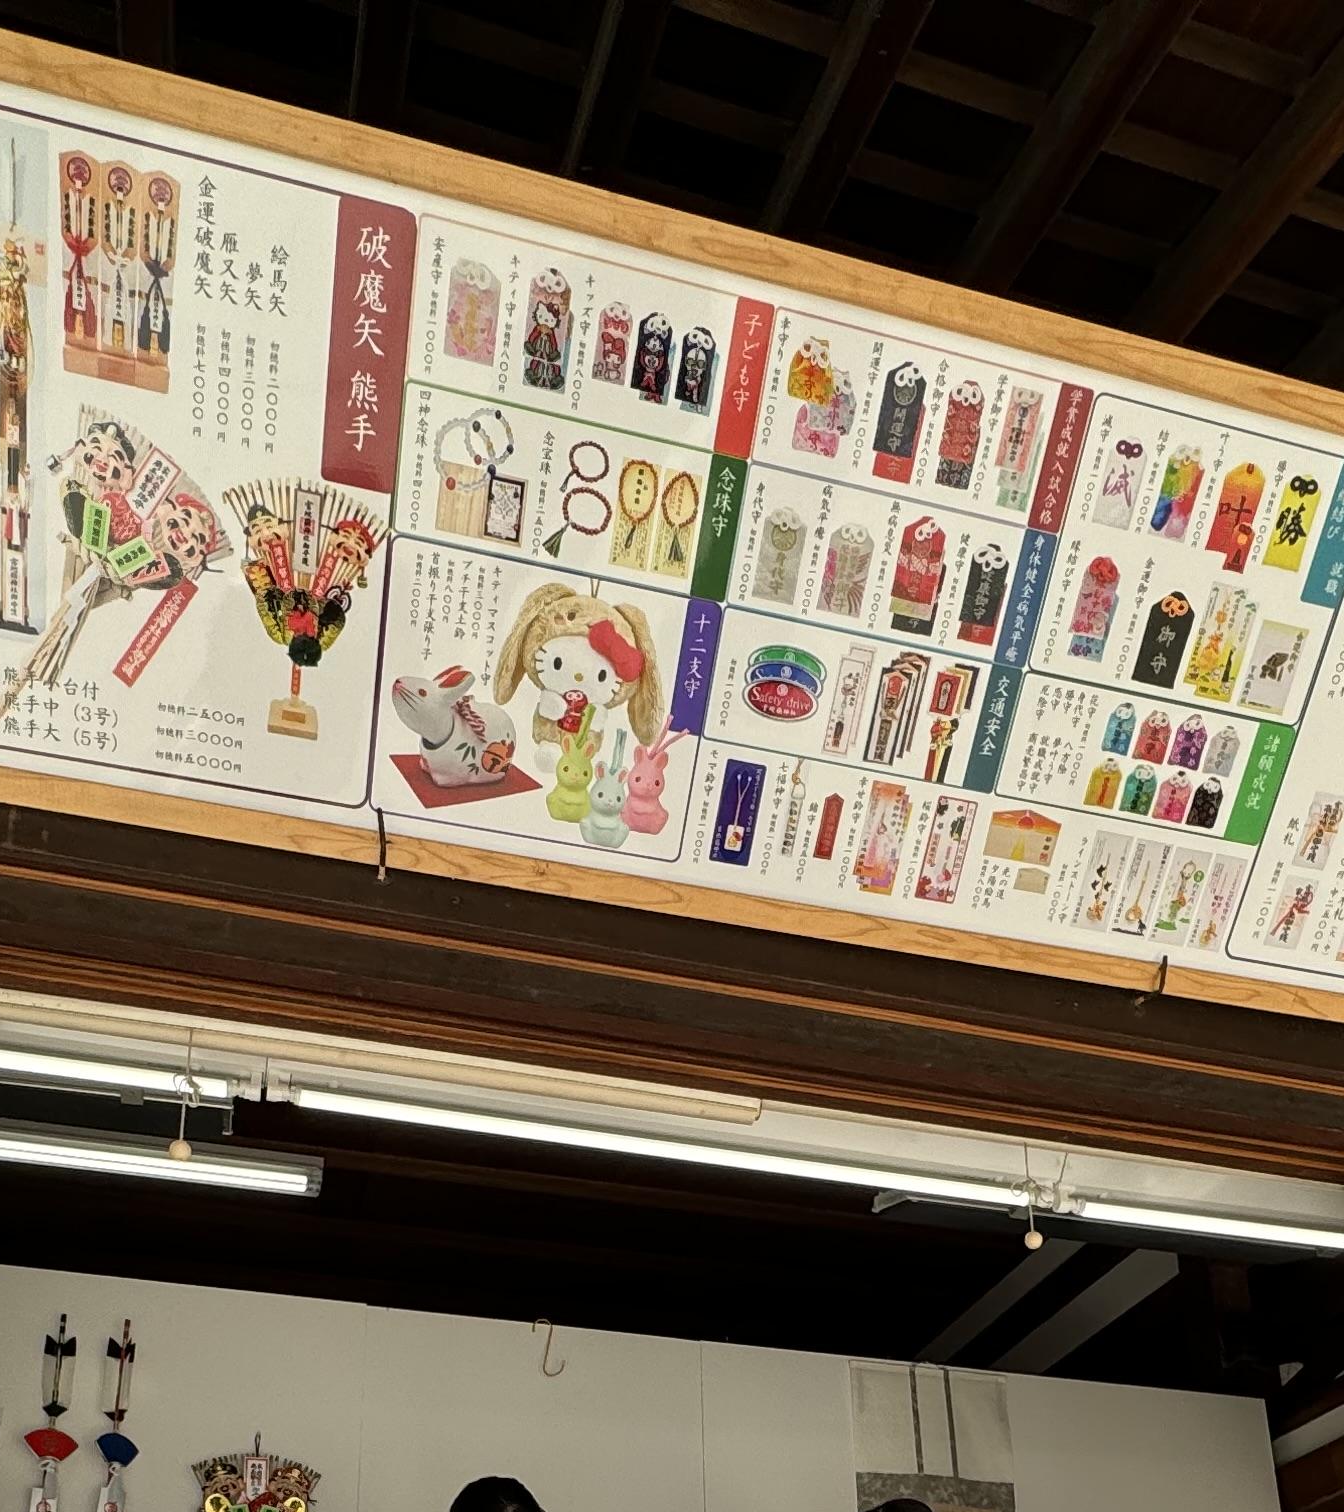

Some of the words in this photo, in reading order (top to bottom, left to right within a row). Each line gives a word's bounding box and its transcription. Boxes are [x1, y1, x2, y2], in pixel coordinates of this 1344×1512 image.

[193, 175, 218, 299] 金運破魔矢
[219, 232, 240, 305] 雁又矢
[244, 262, 264, 312] 夢矢
[268, 245, 290, 317] 絵馬矢
[352, 226, 393, 357] 破魔矢
[505, 255, 521, 318] キティ守
[732, 314, 761, 413] 子ども守
[344, 370, 379, 452] 熊手
[415, 390, 432, 448] 四神念珠
[711, 466, 736, 538] 念珠守
[1219, 495, 1252, 527] 叶
[1273, 503, 1307, 546] 勝
[684, 614, 710, 699] 十二支守
[2, 715, 61, 743] 熊手大
[3, 691, 60, 719] 熊手中
[749, 686, 786, 708] Safety
[786, 696, 812, 711] drive
[979, 675, 1010, 757] 交通安全
[1284, 817, 1300, 847] 紙札
